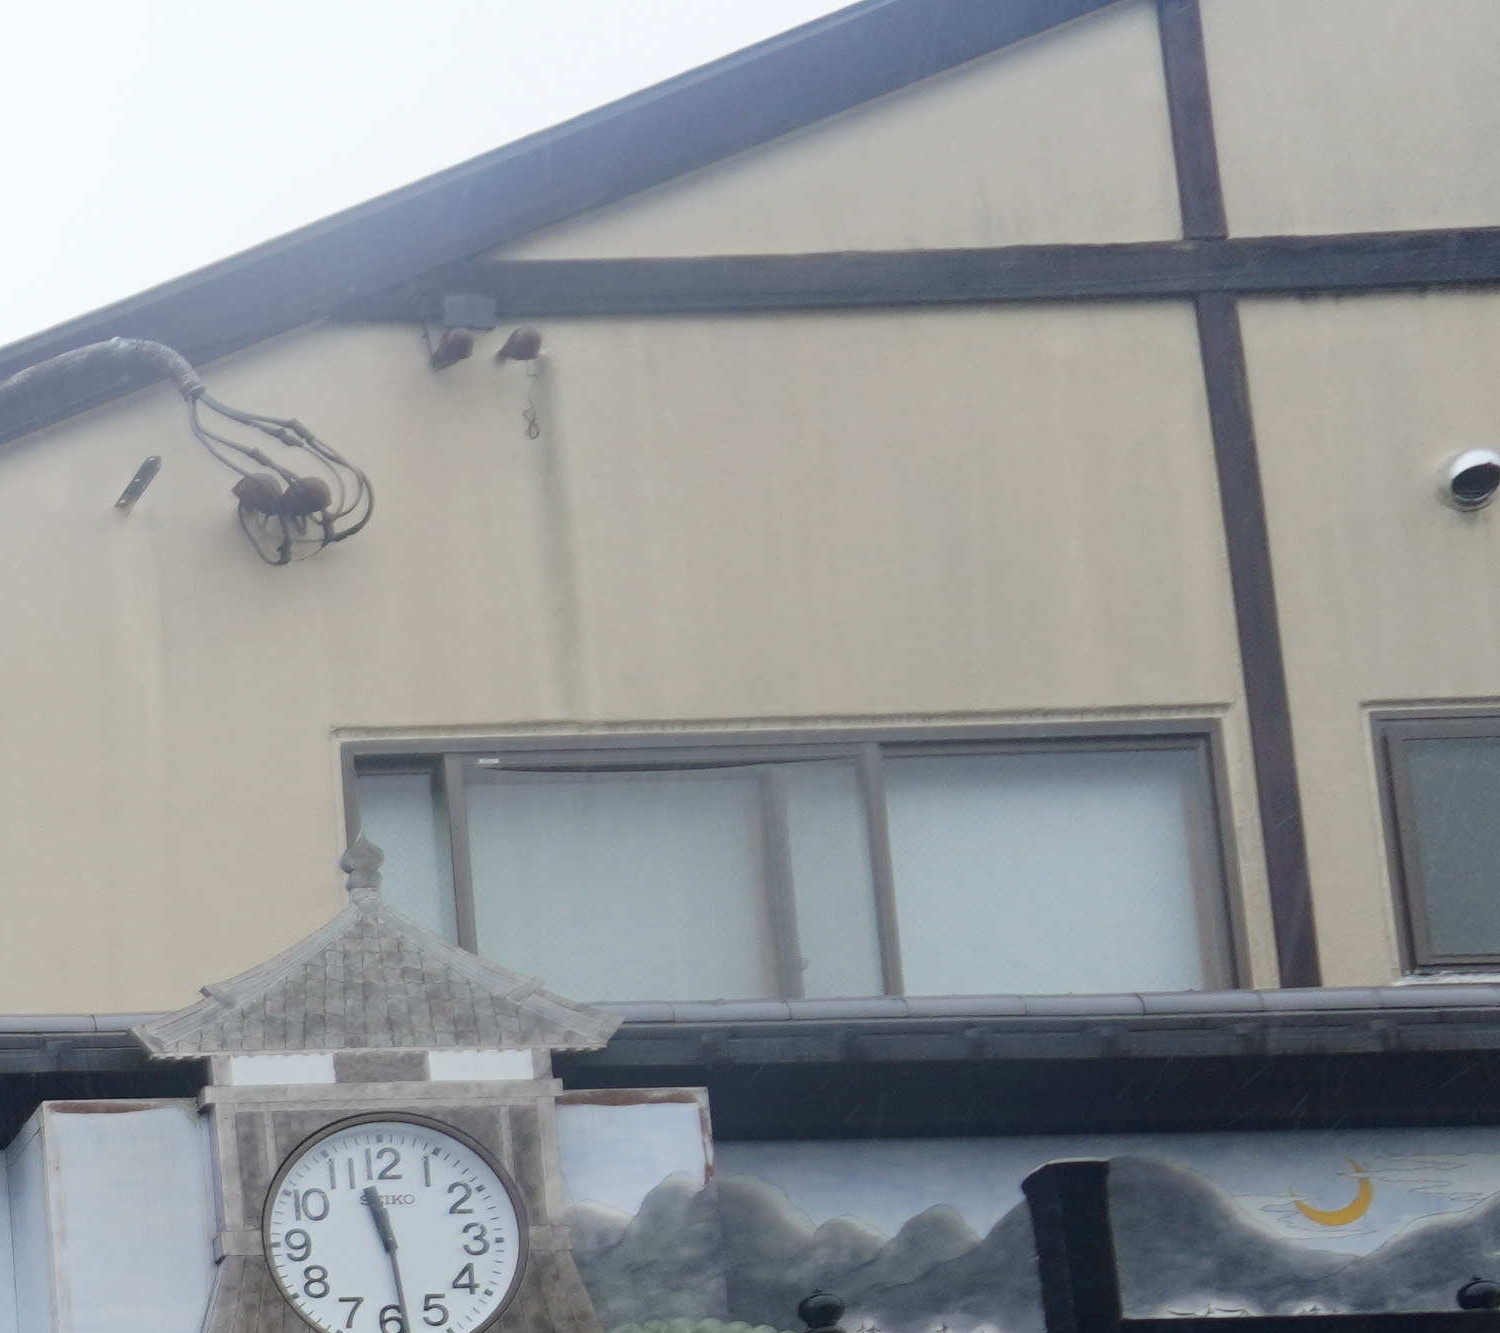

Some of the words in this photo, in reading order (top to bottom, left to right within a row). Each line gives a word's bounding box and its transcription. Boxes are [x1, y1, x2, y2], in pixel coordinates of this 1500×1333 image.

[328, 1157, 356, 1190] 11
[364, 1147, 403, 1181] 12
[422, 1155, 431, 1187] 1
[294, 1188, 330, 1221] 10
[448, 1181, 474, 1214] 2
[285, 1229, 312, 1262] 9
[462, 1222, 490, 1256] 3
[303, 1265, 330, 1298] 8
[452, 1262, 480, 1295] 4
[338, 1296, 364, 1329] 7
[423, 1293, 449, 1327] 5
